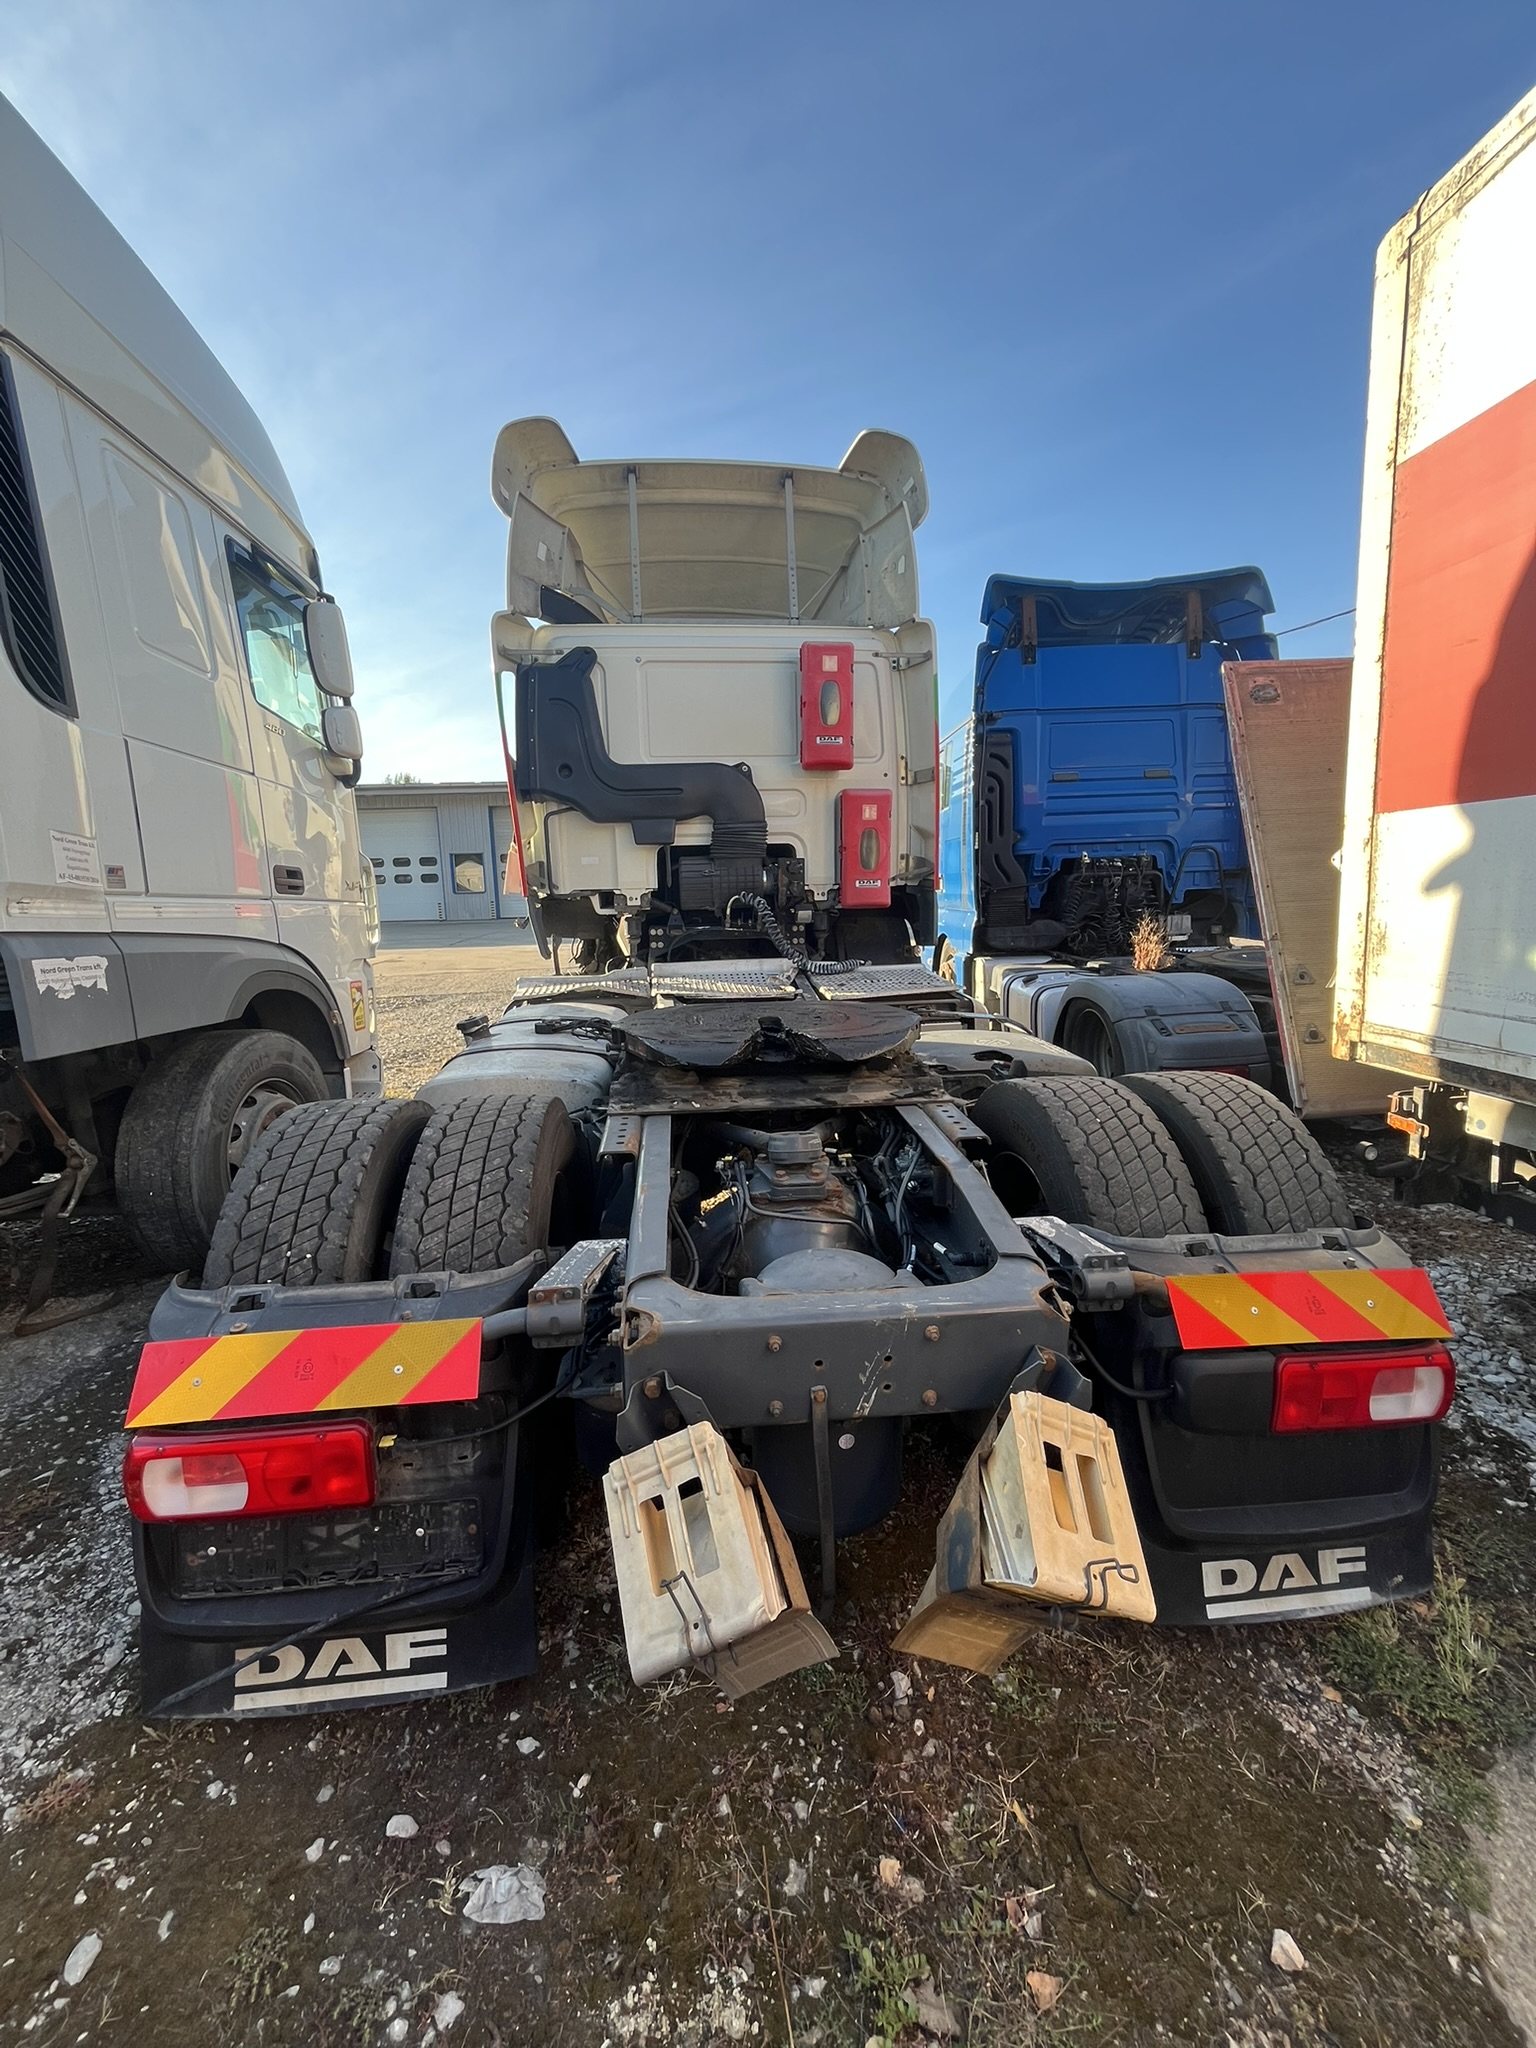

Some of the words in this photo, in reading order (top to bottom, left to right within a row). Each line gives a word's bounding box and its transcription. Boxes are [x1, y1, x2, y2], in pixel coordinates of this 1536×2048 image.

[40, 967, 57, 975] Nord
[76, 964, 93, 972] Trans
[219, 1055, 266, 1124] Continental
[1201, 1546, 1367, 1598] DAF
[234, 1628, 447, 1688] DAF
